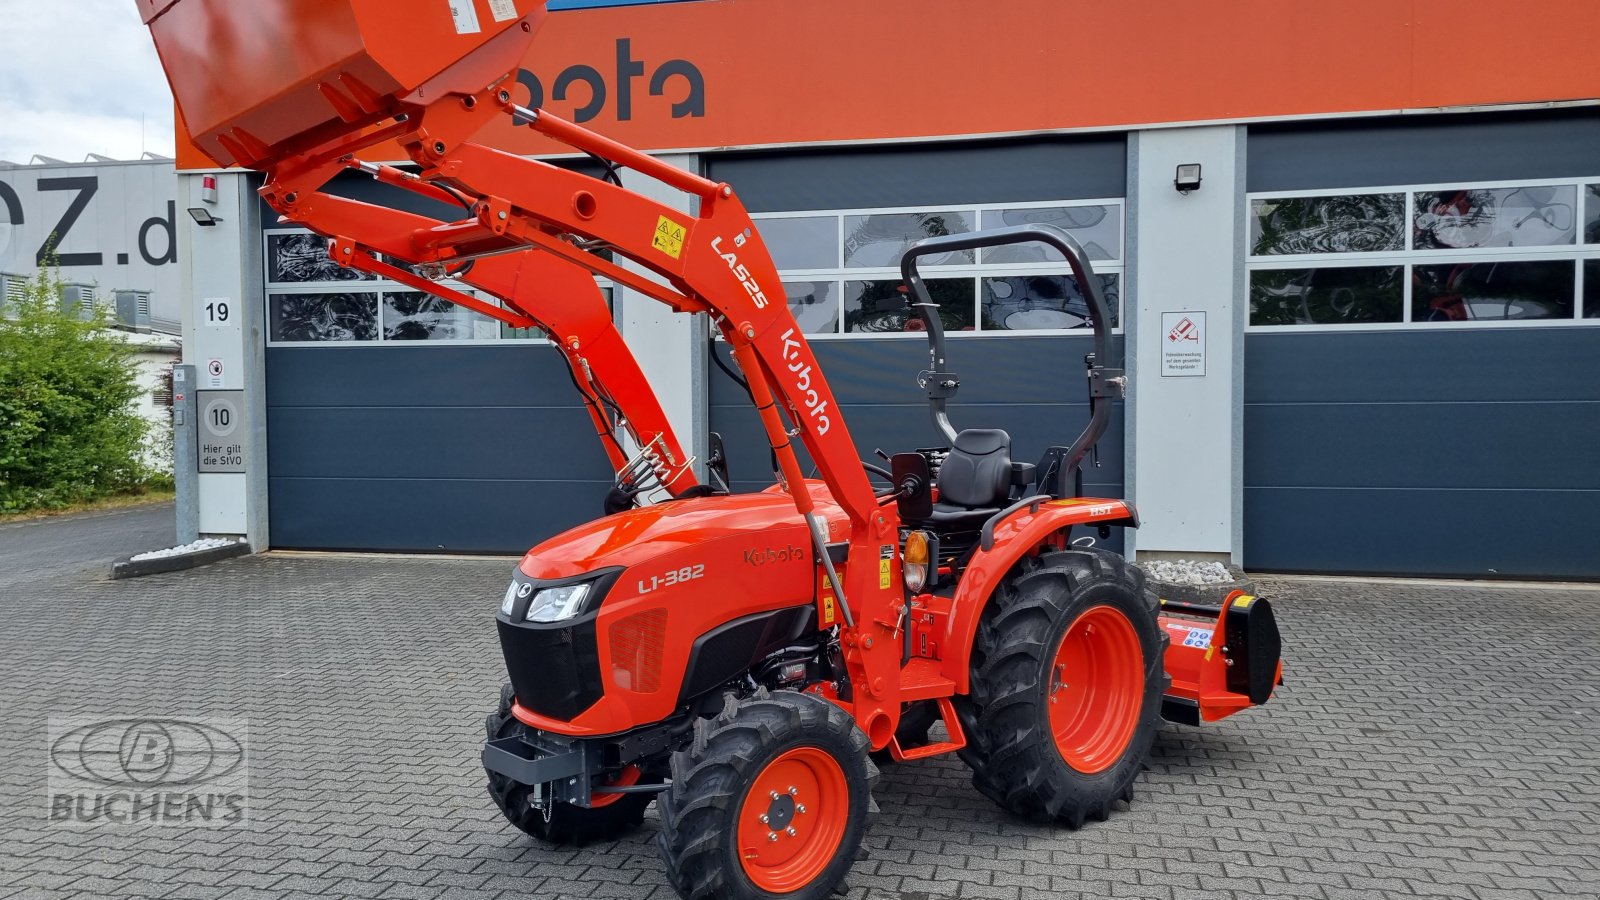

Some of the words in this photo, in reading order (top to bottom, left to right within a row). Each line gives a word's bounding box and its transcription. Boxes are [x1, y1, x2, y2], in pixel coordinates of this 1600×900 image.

[711, 236, 769, 309] LA525
[206, 302, 229, 321] 19
[780, 328, 830, 436] Kubota
[213, 408, 229, 426] 10
[203, 444, 222, 454] Hier
[227, 443, 242, 456] gilt
[203, 456, 217, 465] die
[220, 455, 242, 465] StVO
[1089, 505, 1113, 517] HST
[743, 545, 804, 566] Kubota
[638, 563, 705, 595] L1-382
